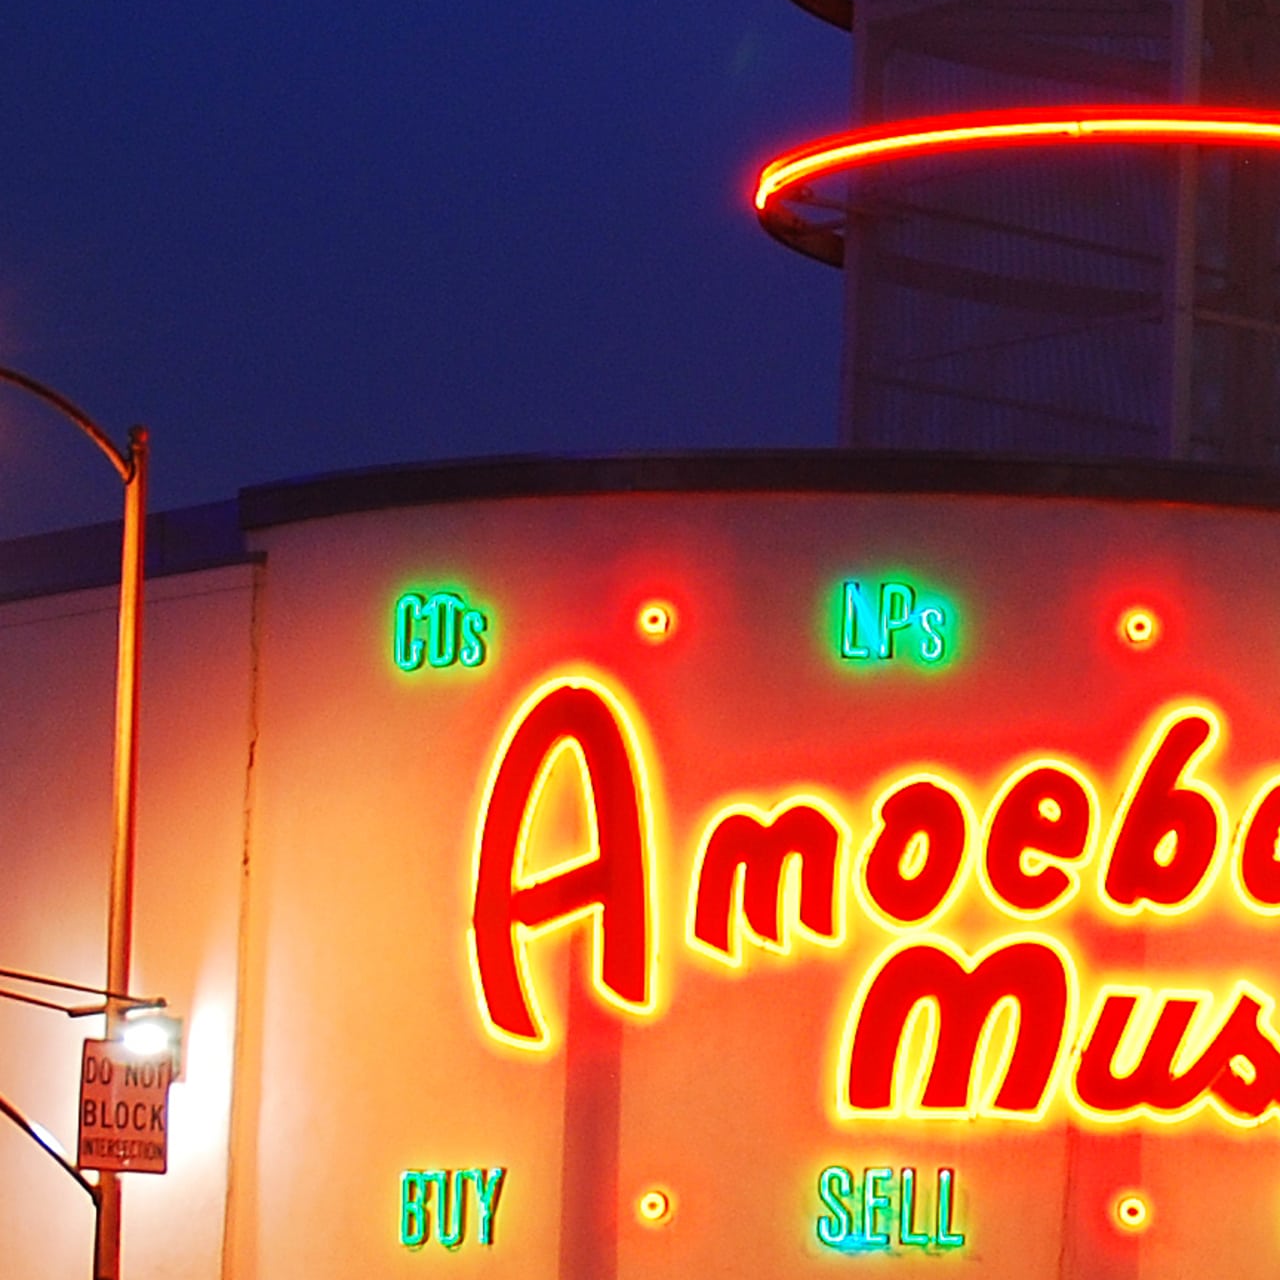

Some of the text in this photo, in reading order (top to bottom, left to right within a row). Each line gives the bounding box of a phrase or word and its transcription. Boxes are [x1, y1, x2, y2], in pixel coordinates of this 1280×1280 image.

[395, 591, 489, 672] CDs
[839, 581, 948, 664] LPs
[85, 1056, 113, 1086] DO
[83, 1099, 166, 1132] BLOCK
[399, 1166, 508, 1248] BUY
[816, 1165, 966, 1252] SELL
